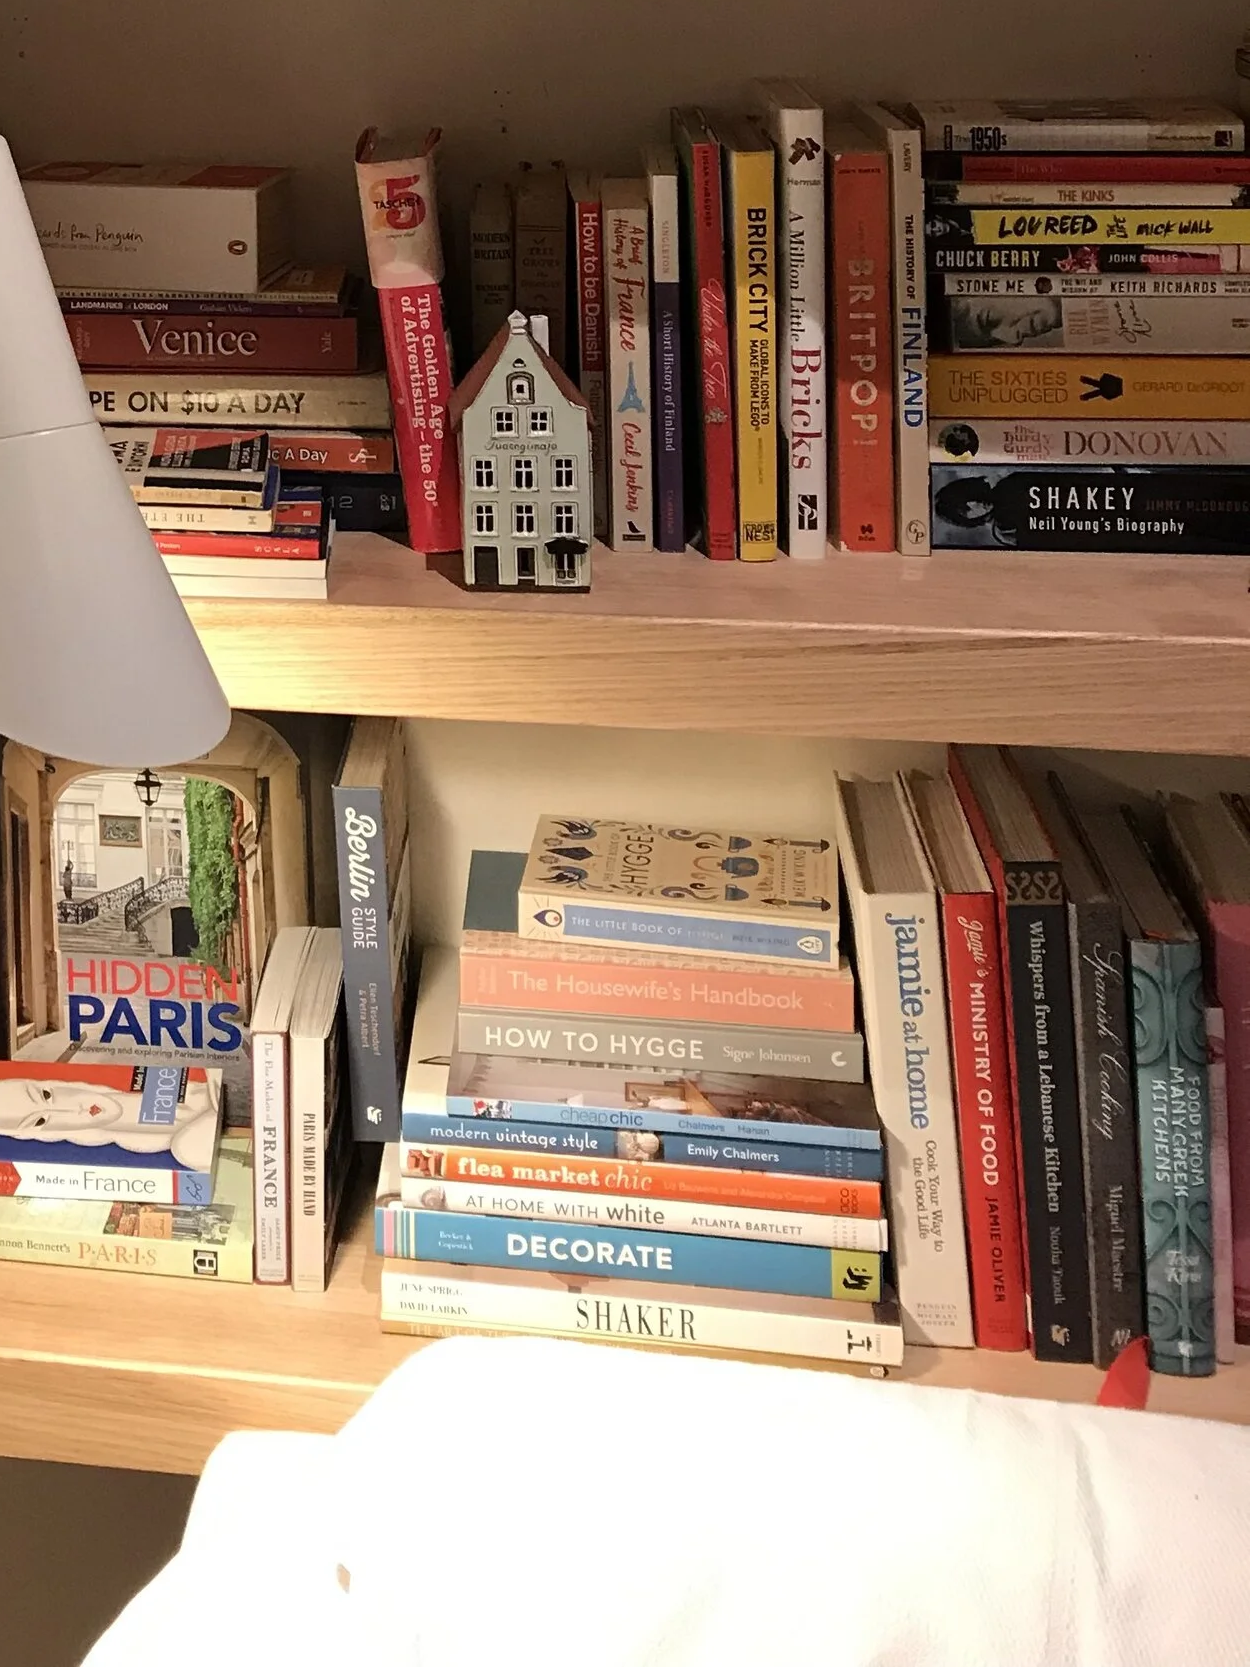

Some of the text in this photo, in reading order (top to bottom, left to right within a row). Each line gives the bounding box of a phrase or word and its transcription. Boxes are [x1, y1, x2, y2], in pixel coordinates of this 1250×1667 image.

[1057, 191, 1115, 202] THE KINKS
[998, 215, 1098, 238] LOU REED
[746, 208, 769, 333] BRICK CITY
[936, 250, 1040, 267] CHUCK BERRY
[132, 318, 257, 355] Venice
[789, 210, 822, 470] A Million Little Bricks
[902, 215, 924, 428] THE HISTORY OF FINLAND
[400, 295, 429, 428] of Advertising
[417, 294, 443, 439] The Golden Age
[128, 391, 168, 413] ON
[227, 392, 245, 413] A
[254, 391, 306, 414] DAY
[1064, 431, 1228, 457] DONOVAN
[1029, 486, 1135, 510] SHAKEY
[1029, 517, 1185, 535] Neil Young's Biography
[345, 807, 377, 902] Berlin
[351, 908, 365, 949] GUIDE
[364, 908, 377, 949] STYLE
[67, 958, 238, 1000] HIDDEN
[68, 995, 242, 1052] PARIS
[885, 913, 935, 1129] jamie at home
[969, 983, 994, 1084] MINISTRY
[484, 1026, 704, 1060] HOW TO HYGGE
[1025, 921, 1063, 1212] Whispers from a Lebanese Kitchen
[977, 1088, 995, 1117] OF
[430, 1125, 598, 1151] modern vintage style
[979, 1124, 1000, 1185] FOOD
[36, 1170, 157, 1194] Made in France
[263, 1125, 278, 1208] FRANCE
[457, 1157, 653, 1191] flea market chic
[986, 1196, 1005, 1239] JAMIE
[507, 1233, 673, 1270] DECORATE
[991, 1245, 1007, 1303] OLIVER
[575, 1298, 697, 1341] SHAKER
